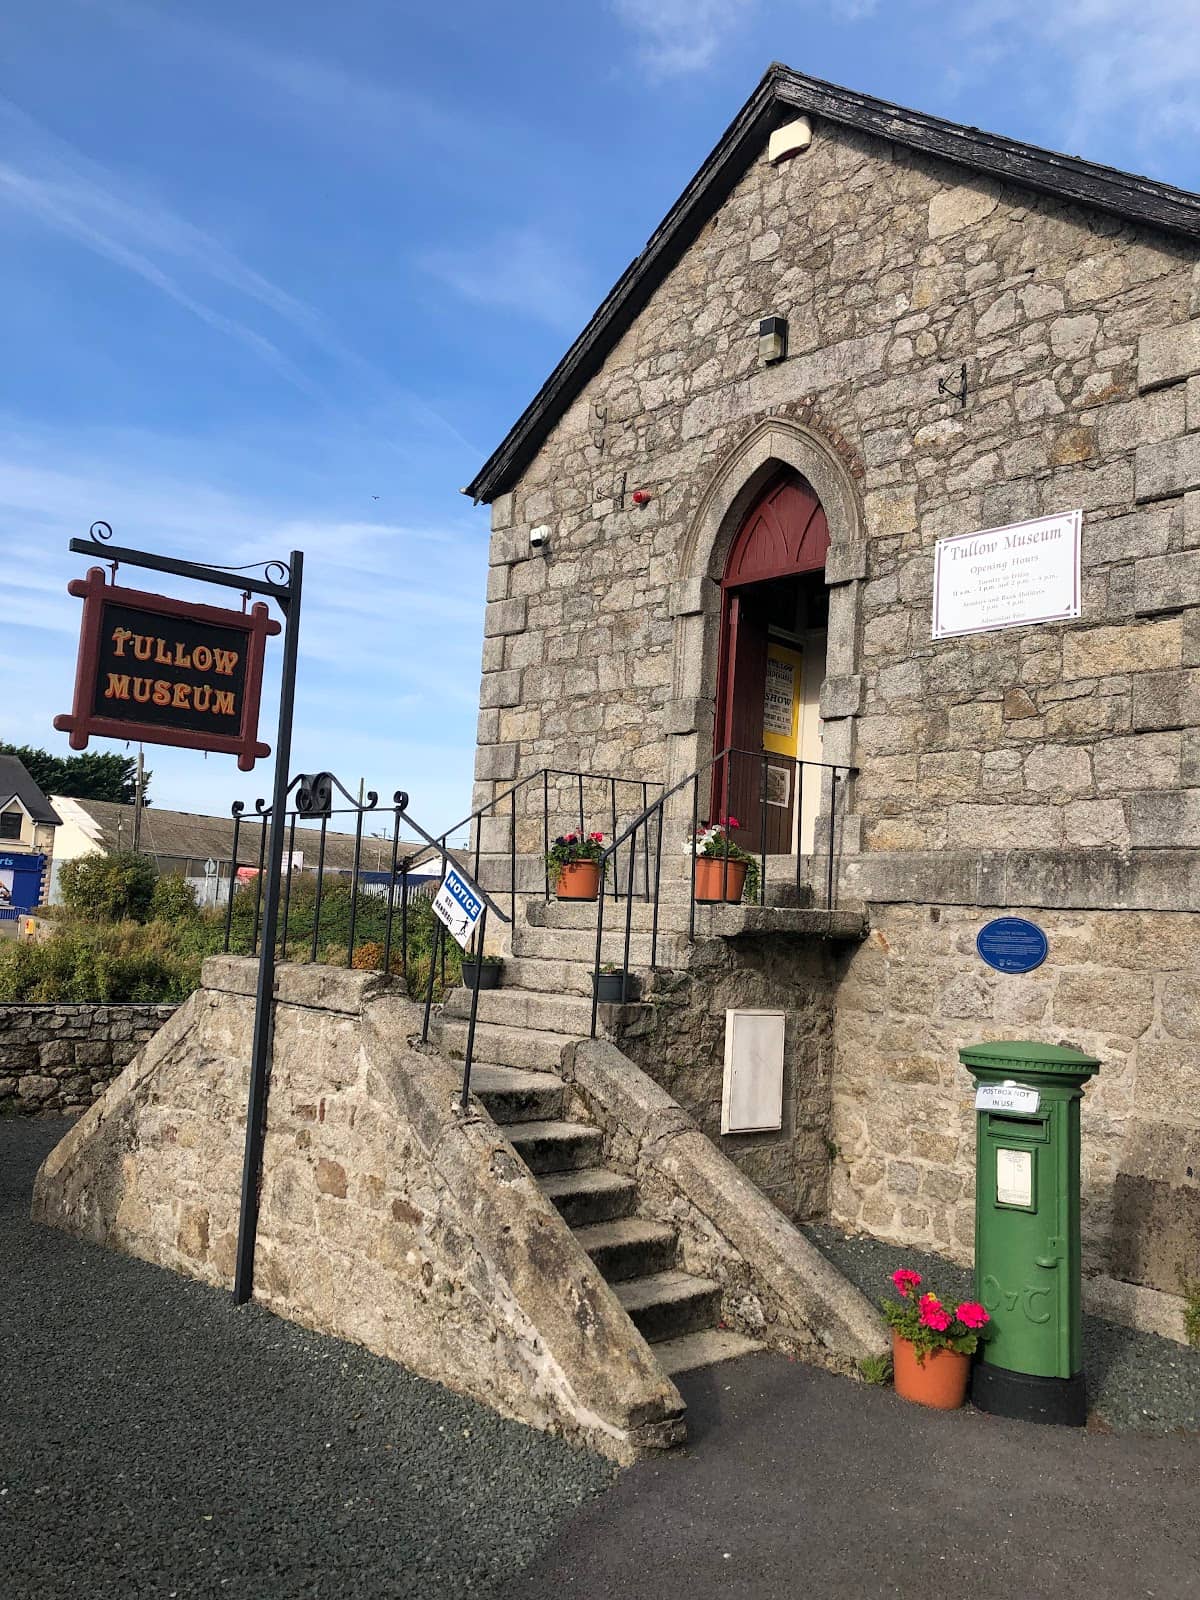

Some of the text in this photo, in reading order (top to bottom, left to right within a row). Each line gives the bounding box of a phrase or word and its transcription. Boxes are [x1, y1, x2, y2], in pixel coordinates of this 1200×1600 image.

[950, 527, 1062, 561] Tullow Museum
[969, 554, 1039, 575] Opening Hours
[111, 626, 239, 676] TULLOW
[104, 672, 236, 715] MUSEUM
[765, 692, 792, 706] SHOW
[447, 875, 480, 917] NOTICE
[982, 1088, 1012, 1096] POSTBOX
